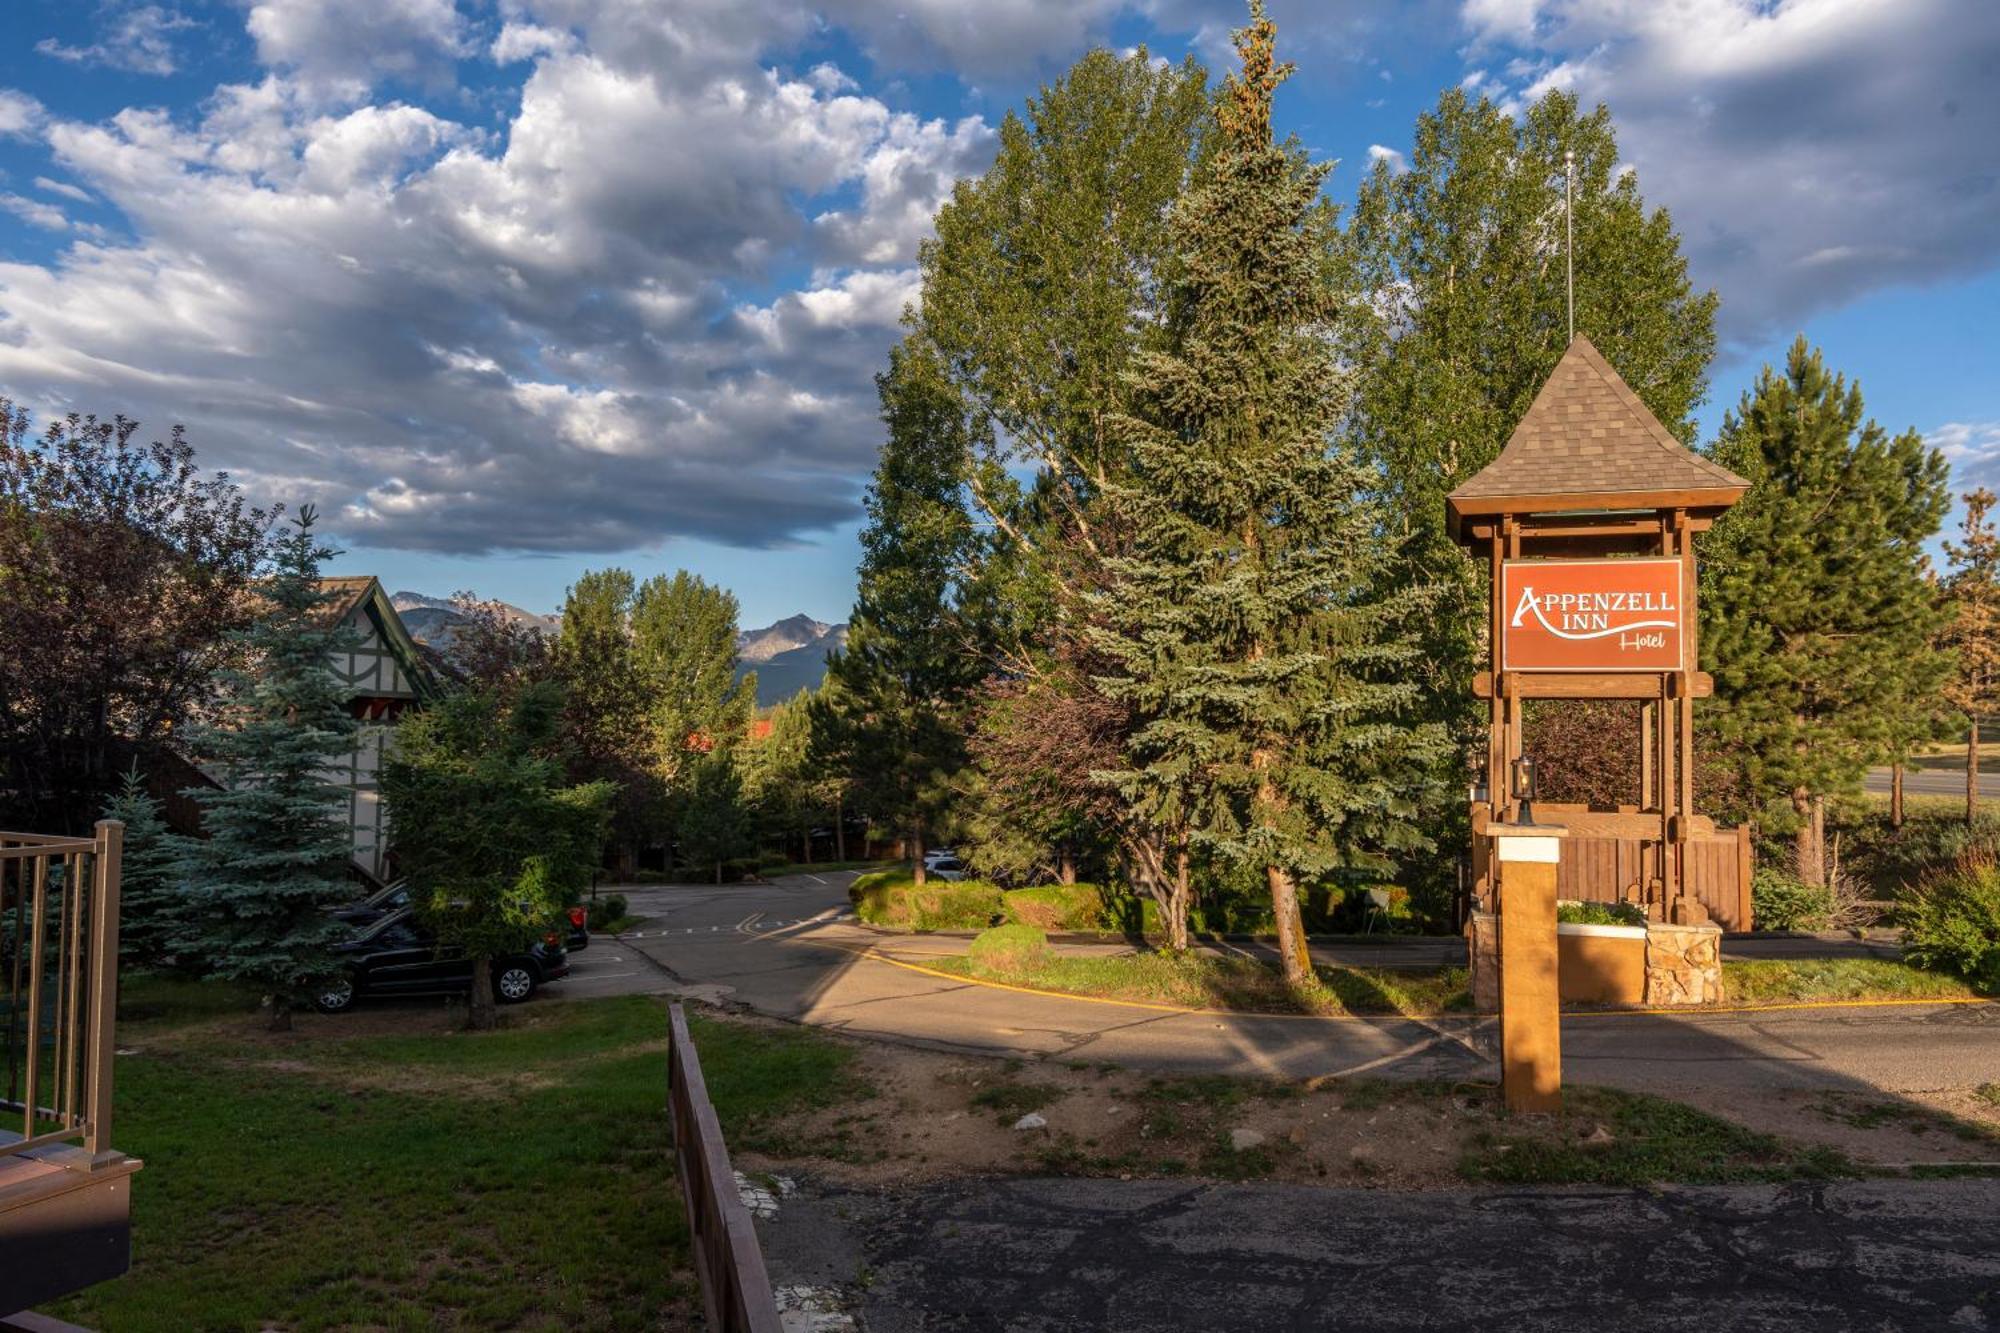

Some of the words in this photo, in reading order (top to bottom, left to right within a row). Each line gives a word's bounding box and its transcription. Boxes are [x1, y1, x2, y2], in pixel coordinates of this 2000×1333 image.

[1512, 587, 1675, 627] APPENZELL
[1562, 613, 1609, 630] INN
[1619, 632, 1666, 651] Hotel
